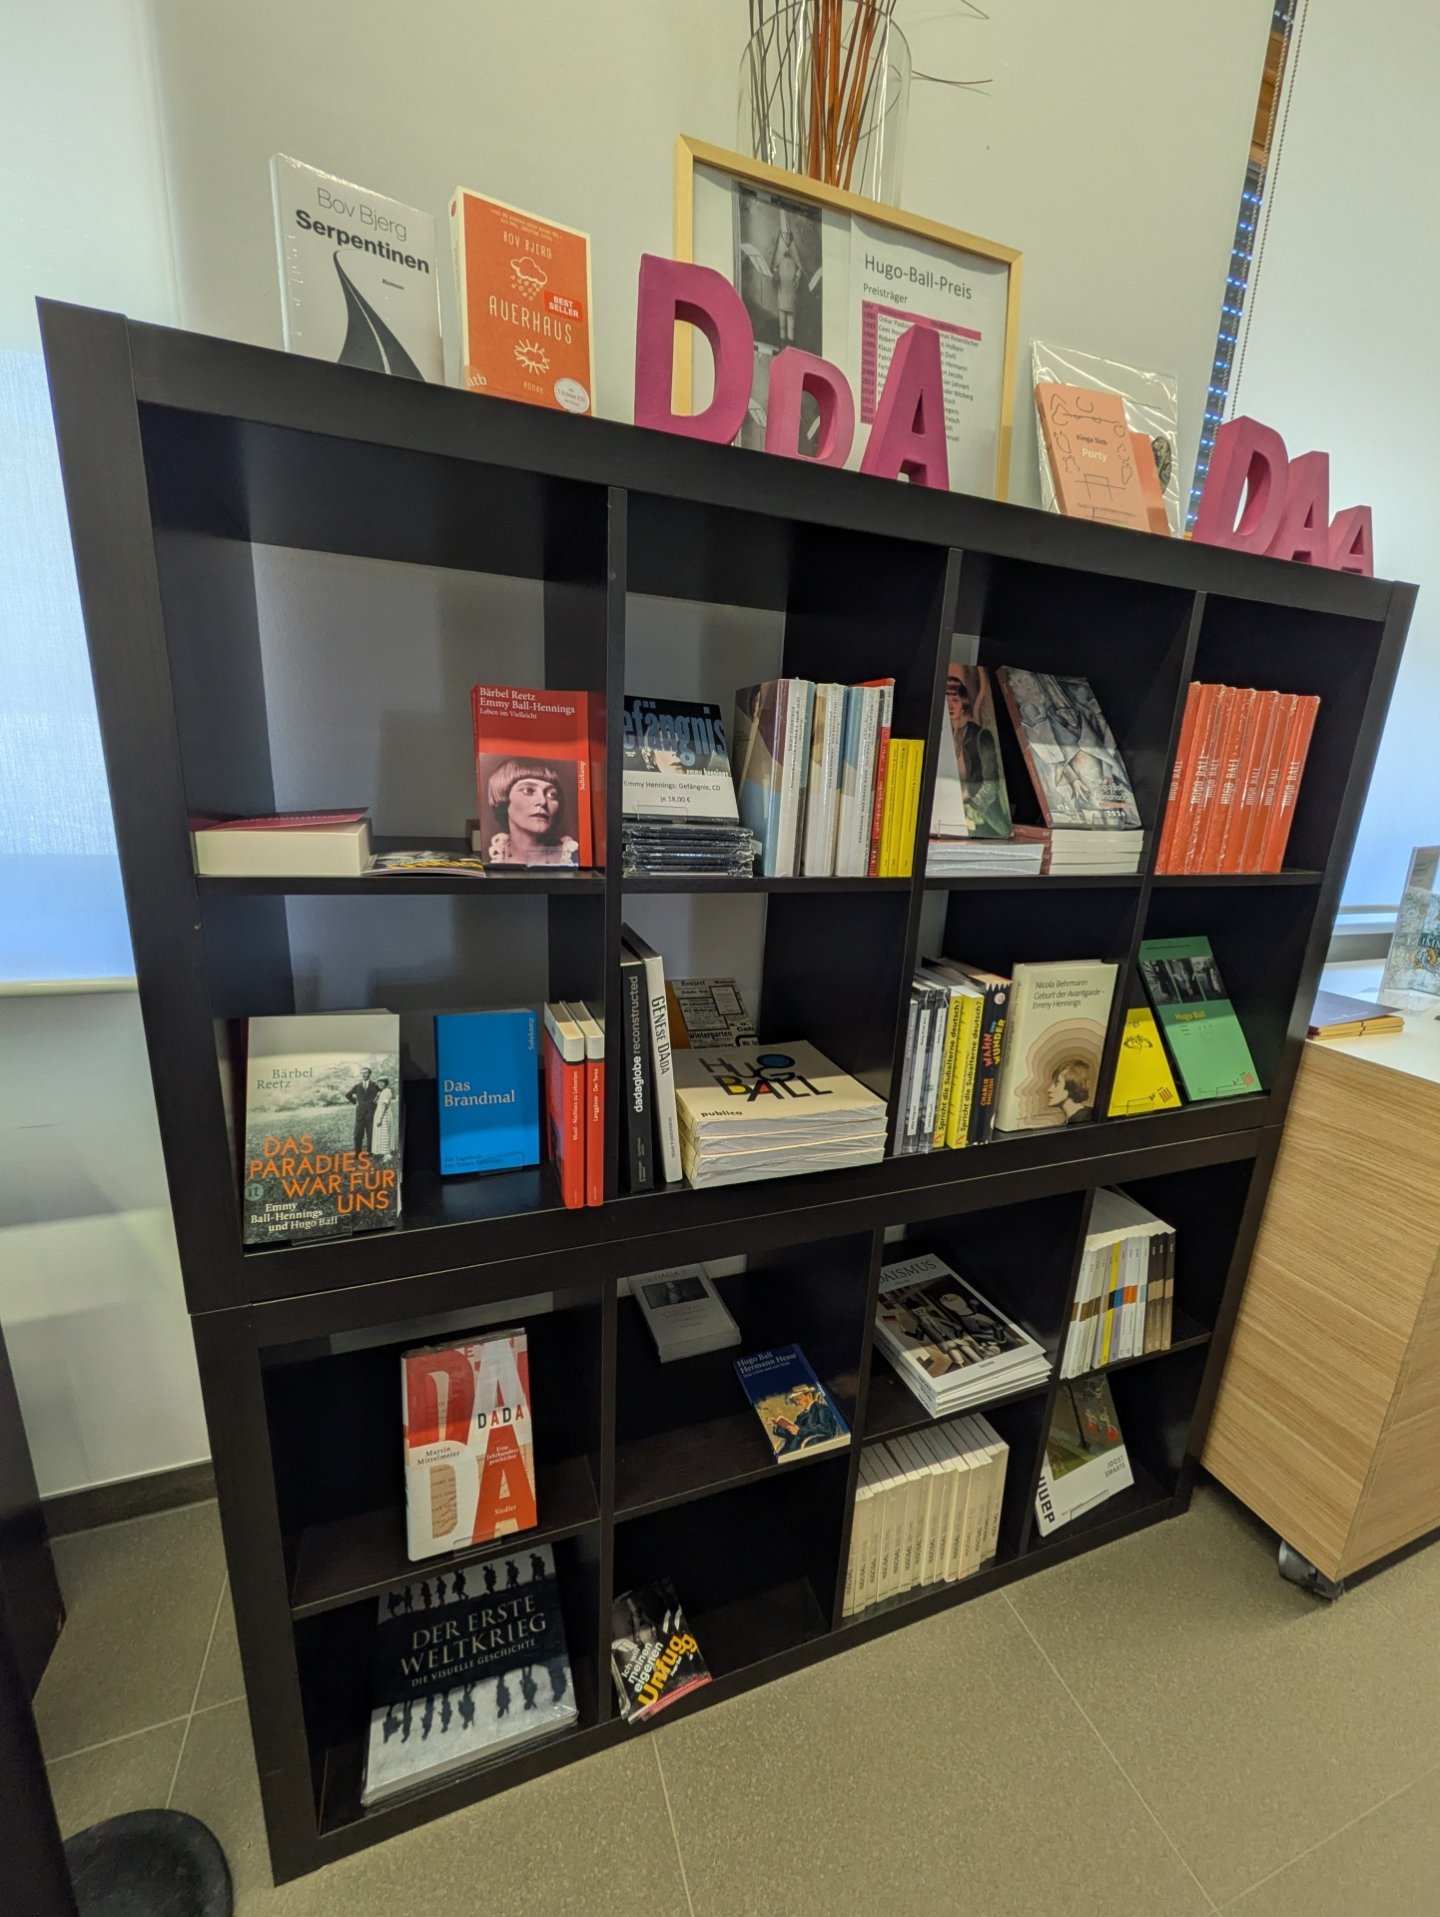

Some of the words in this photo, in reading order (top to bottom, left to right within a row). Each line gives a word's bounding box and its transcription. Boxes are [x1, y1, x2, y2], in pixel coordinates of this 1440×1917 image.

[317, 188, 356, 218] Bov
[360, 205, 407, 241] Bjerg
[295, 209, 430, 274] Serpentinen
[503, 231, 520, 248] BOV
[525, 240, 552, 260] BJERG
[865, 254, 972, 300] Hugo-Ball-Preis
[553, 295, 574, 308] BEST
[863, 283, 908, 304] Preisträger
[489, 295, 573, 345] AUERHAUS
[549, 302, 579, 318] SELLER
[1082, 447, 1108, 463] Party
[480, 687, 509, 699] Bärbel
[511, 691, 536, 701] Reetz
[480, 698, 509, 710] Emmy
[512, 701, 575, 716] Ball-Hennings
[480, 708, 498, 716] Leben
[624, 699, 729, 766] efängnis
[1034, 991, 1055, 1000] Geburt
[1057, 990, 1066, 998] der
[1036, 981, 1055, 989] Nicola
[1056, 979, 1088, 988] Behrmann
[630, 975, 640, 1054] reconstructed
[651, 995, 666, 1043] GENESE
[950, 999, 960, 1038] deutsch?
[1032, 1001, 1052, 1010] Emmy
[1053, 1000, 1081, 1009] Hennings
[971, 1000, 982, 1039] deutsch?
[688, 1031, 733, 1040] Wintergarten
[993, 1019, 1006, 1065] WUNDER
[657, 1041, 672, 1076] DADA
[944, 1040, 956, 1085] Subalterne
[965, 1041, 977, 1086] Subalterne
[981, 1033, 993, 1067] WAHN
[272, 1067, 313, 1079] Bärbel
[698, 1053, 796, 1082] HUGO
[256, 1079, 292, 1090] Reetz
[444, 1080, 471, 1092] Das
[444, 1089, 515, 1107] Brandmal
[633, 1055, 644, 1113] dadaglobe
[713, 1074, 833, 1103] BALL
[942, 1087, 950, 1100] die
[963, 1088, 971, 1101] die
[980, 1078, 989, 1106] CHARLIE
[938, 1102, 949, 1131] Spricht
[960, 1104, 970, 1132] Spricht
[263, 1134, 314, 1157] DAS
[250, 1150, 371, 1180] PARADIES
[281, 1174, 342, 1199] WAR
[349, 1167, 396, 1192] FÜR
[265, 1202, 298, 1213] Emmy
[336, 1189, 390, 1215] UNS
[251, 1209, 324, 1224] Ball-Hennings
[268, 1222, 288, 1232] und
[290, 1219, 316, 1231] Hugo
[319, 1215, 338, 1226] Ball
[880, 1260, 937, 1285] DAISMUS
[737, 1356, 758, 1368] Hugo
[758, 1351, 773, 1361] Ball
[740, 1358, 775, 1375] Hermann
[478, 1404, 524, 1429] DADA
[417, 1451, 460, 1466] Mittelmeier
[425, 1446, 451, 1457] Martin
[495, 1504, 517, 1515] Siedler
[412, 1619, 460, 1649] DER
[467, 1594, 536, 1632] ERSTE
[400, 1612, 547, 1676] WELTKRIEG
[411, 1674, 428, 1687] DIE
[431, 1661, 475, 1680] VISUELLE
[477, 1638, 536, 1664] GESCHICHTE
[621, 1663, 633, 1678] Ich
[630, 1648, 640, 1662] will
[628, 1641, 653, 1685] meinen
[634, 1641, 664, 1693] eigenen
[638, 1633, 698, 1706] Unfug
